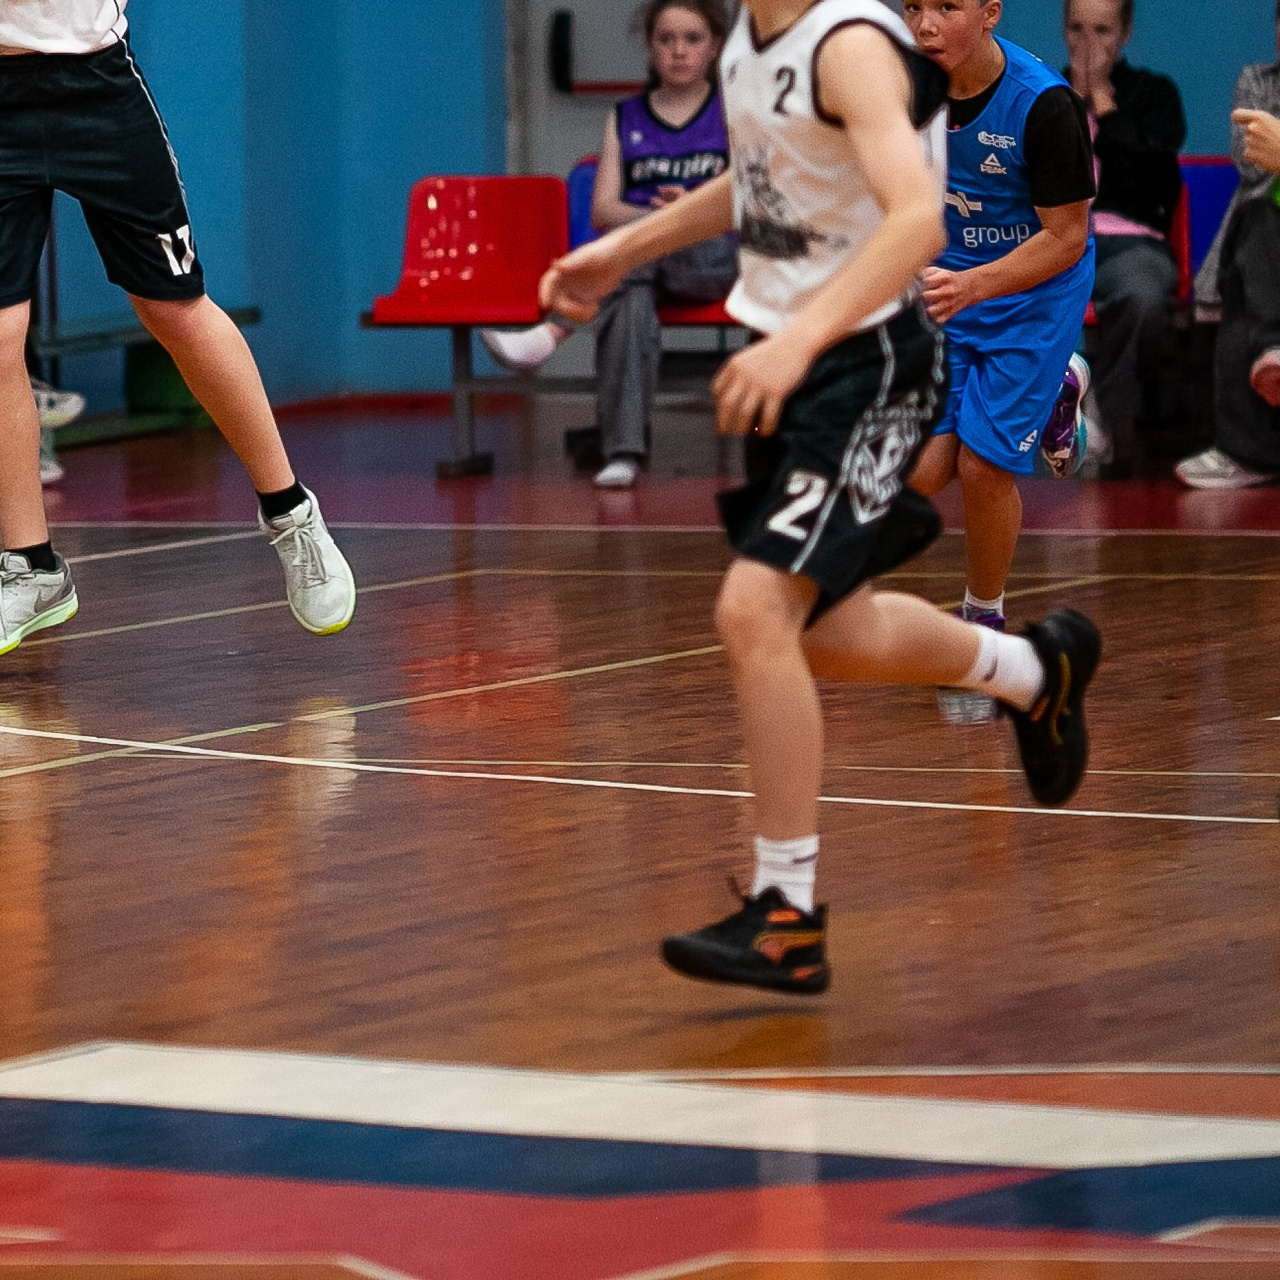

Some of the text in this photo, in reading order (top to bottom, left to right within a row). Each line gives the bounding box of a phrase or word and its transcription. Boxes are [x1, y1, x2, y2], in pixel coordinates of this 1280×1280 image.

[772, 66, 797, 115] 2
[155, 224, 195, 276] 17
[963, 223, 1030, 248] group
[767, 471, 829, 541] 2
